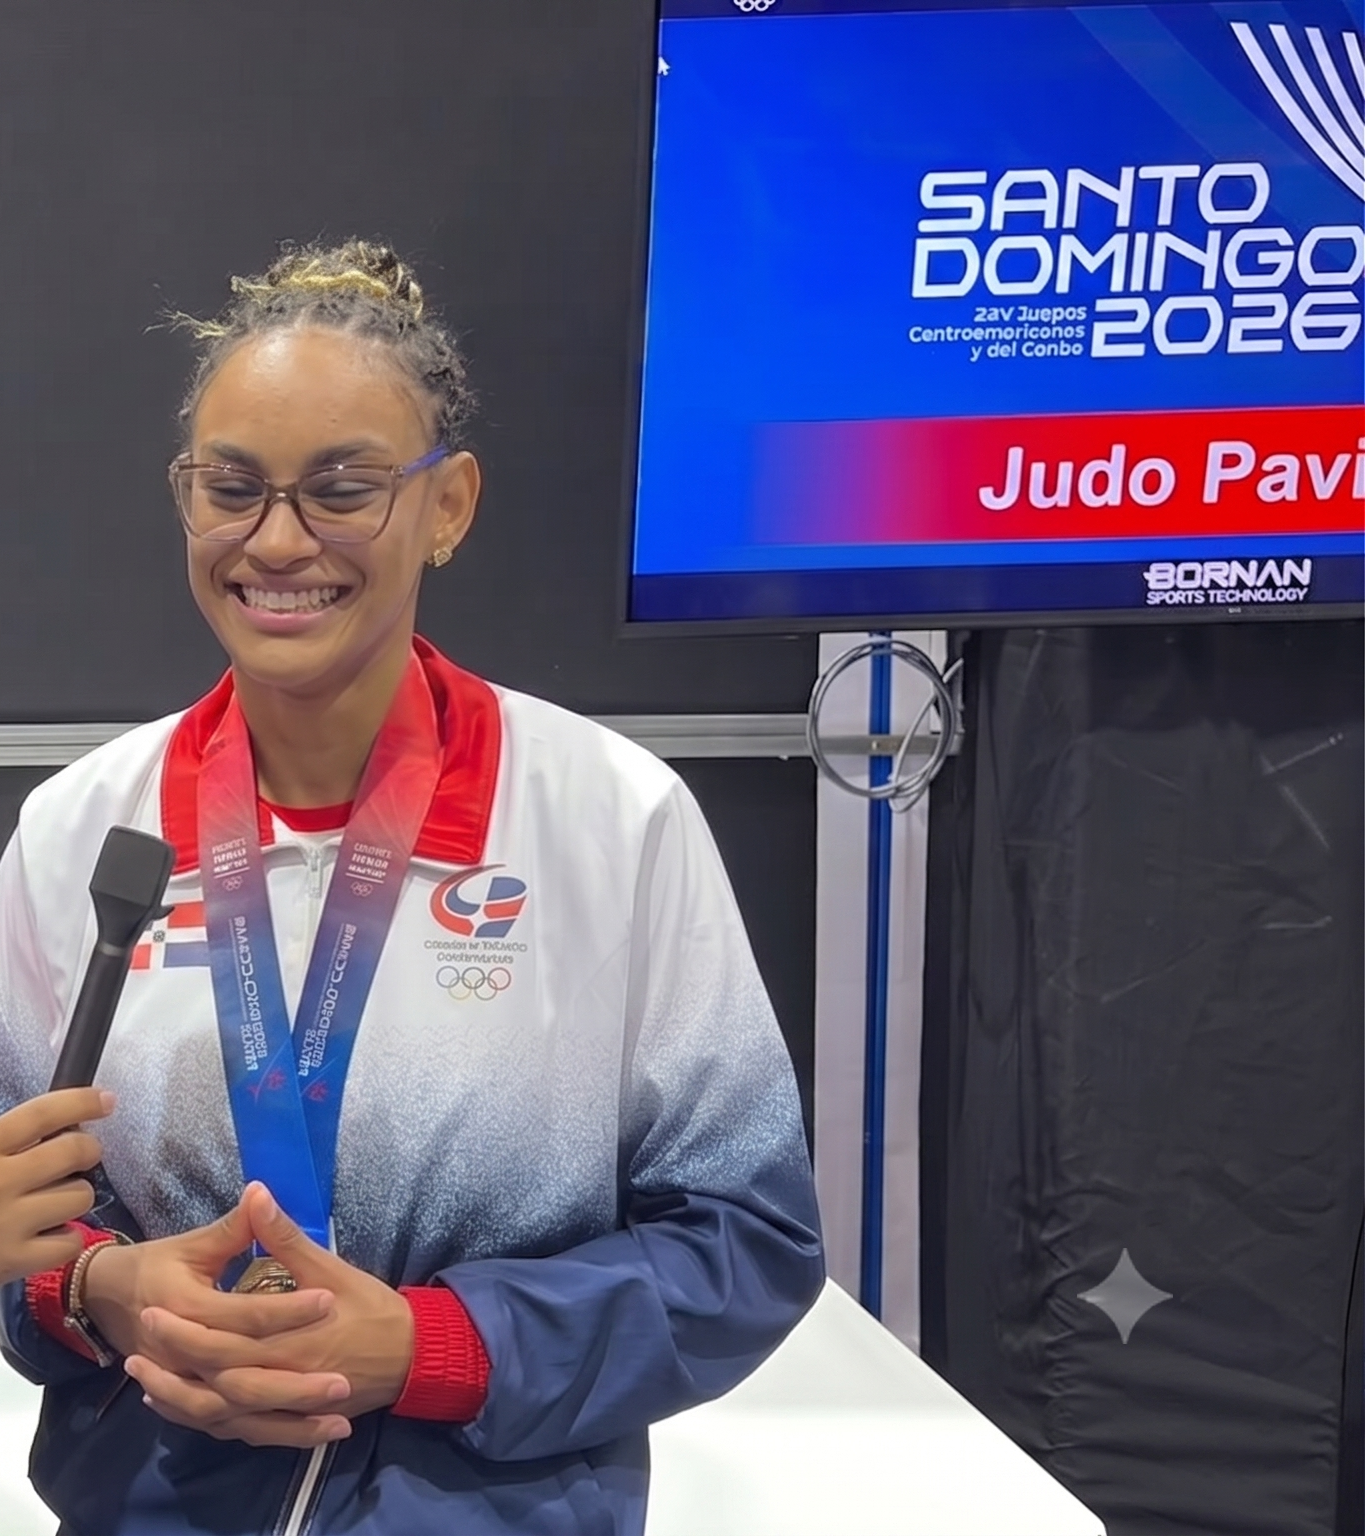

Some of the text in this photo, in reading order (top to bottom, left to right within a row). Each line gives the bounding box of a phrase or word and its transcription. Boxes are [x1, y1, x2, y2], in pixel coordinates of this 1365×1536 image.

[918, 162, 1270, 232] SANTO
[912, 225, 1365, 298] DOMINGO
[970, 345, 983, 362] y
[987, 341, 1017, 358] del
[1090, 291, 1362, 357] 2026
[978, 436, 1365, 510] Judo Pavi
[1142, 558, 1312, 590] BORNAN
[1146, 587, 1309, 605] SPORTS TECHNOLOGY
